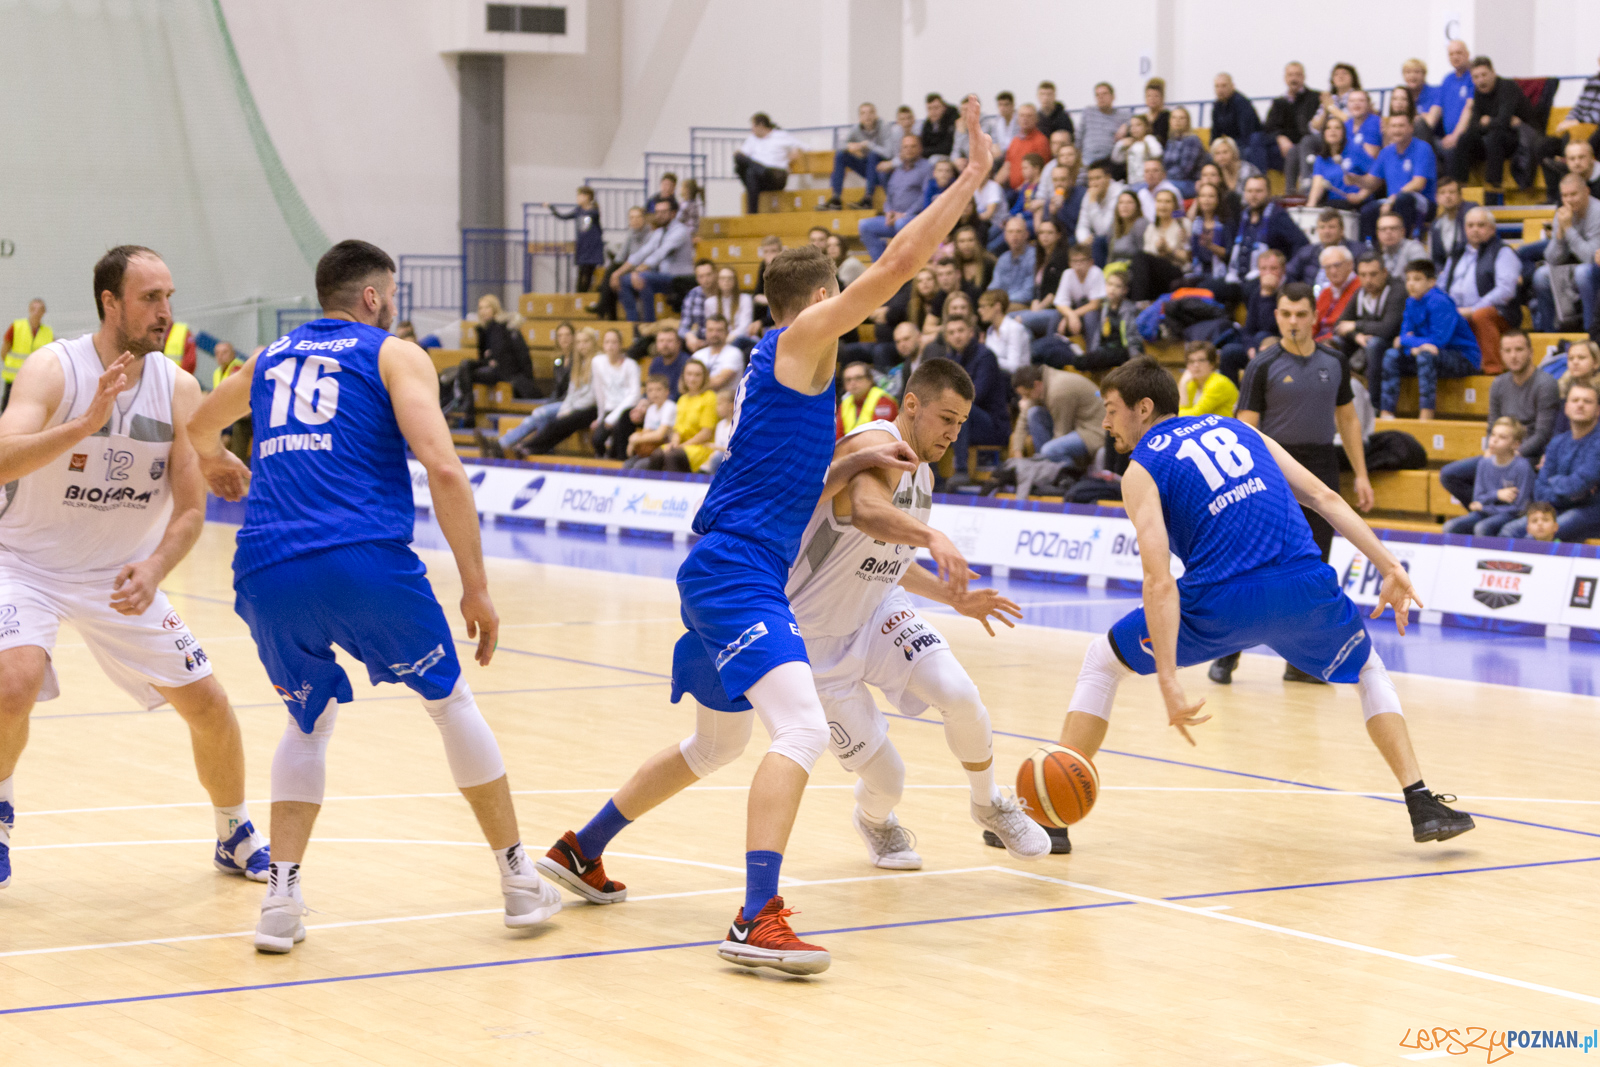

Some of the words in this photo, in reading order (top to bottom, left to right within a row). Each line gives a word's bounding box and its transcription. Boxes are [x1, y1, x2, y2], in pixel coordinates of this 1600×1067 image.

[294, 338, 359, 352] Energa
[264, 354, 343, 428] 16
[259, 433, 333, 459] KOTWICA
[1175, 427, 1254, 492] 18
[103, 447, 134, 481] 12
[1208, 477, 1268, 516] KOTWICA
[1479, 573, 1521, 592] JOKER
[885, 610, 911, 630] KIA
